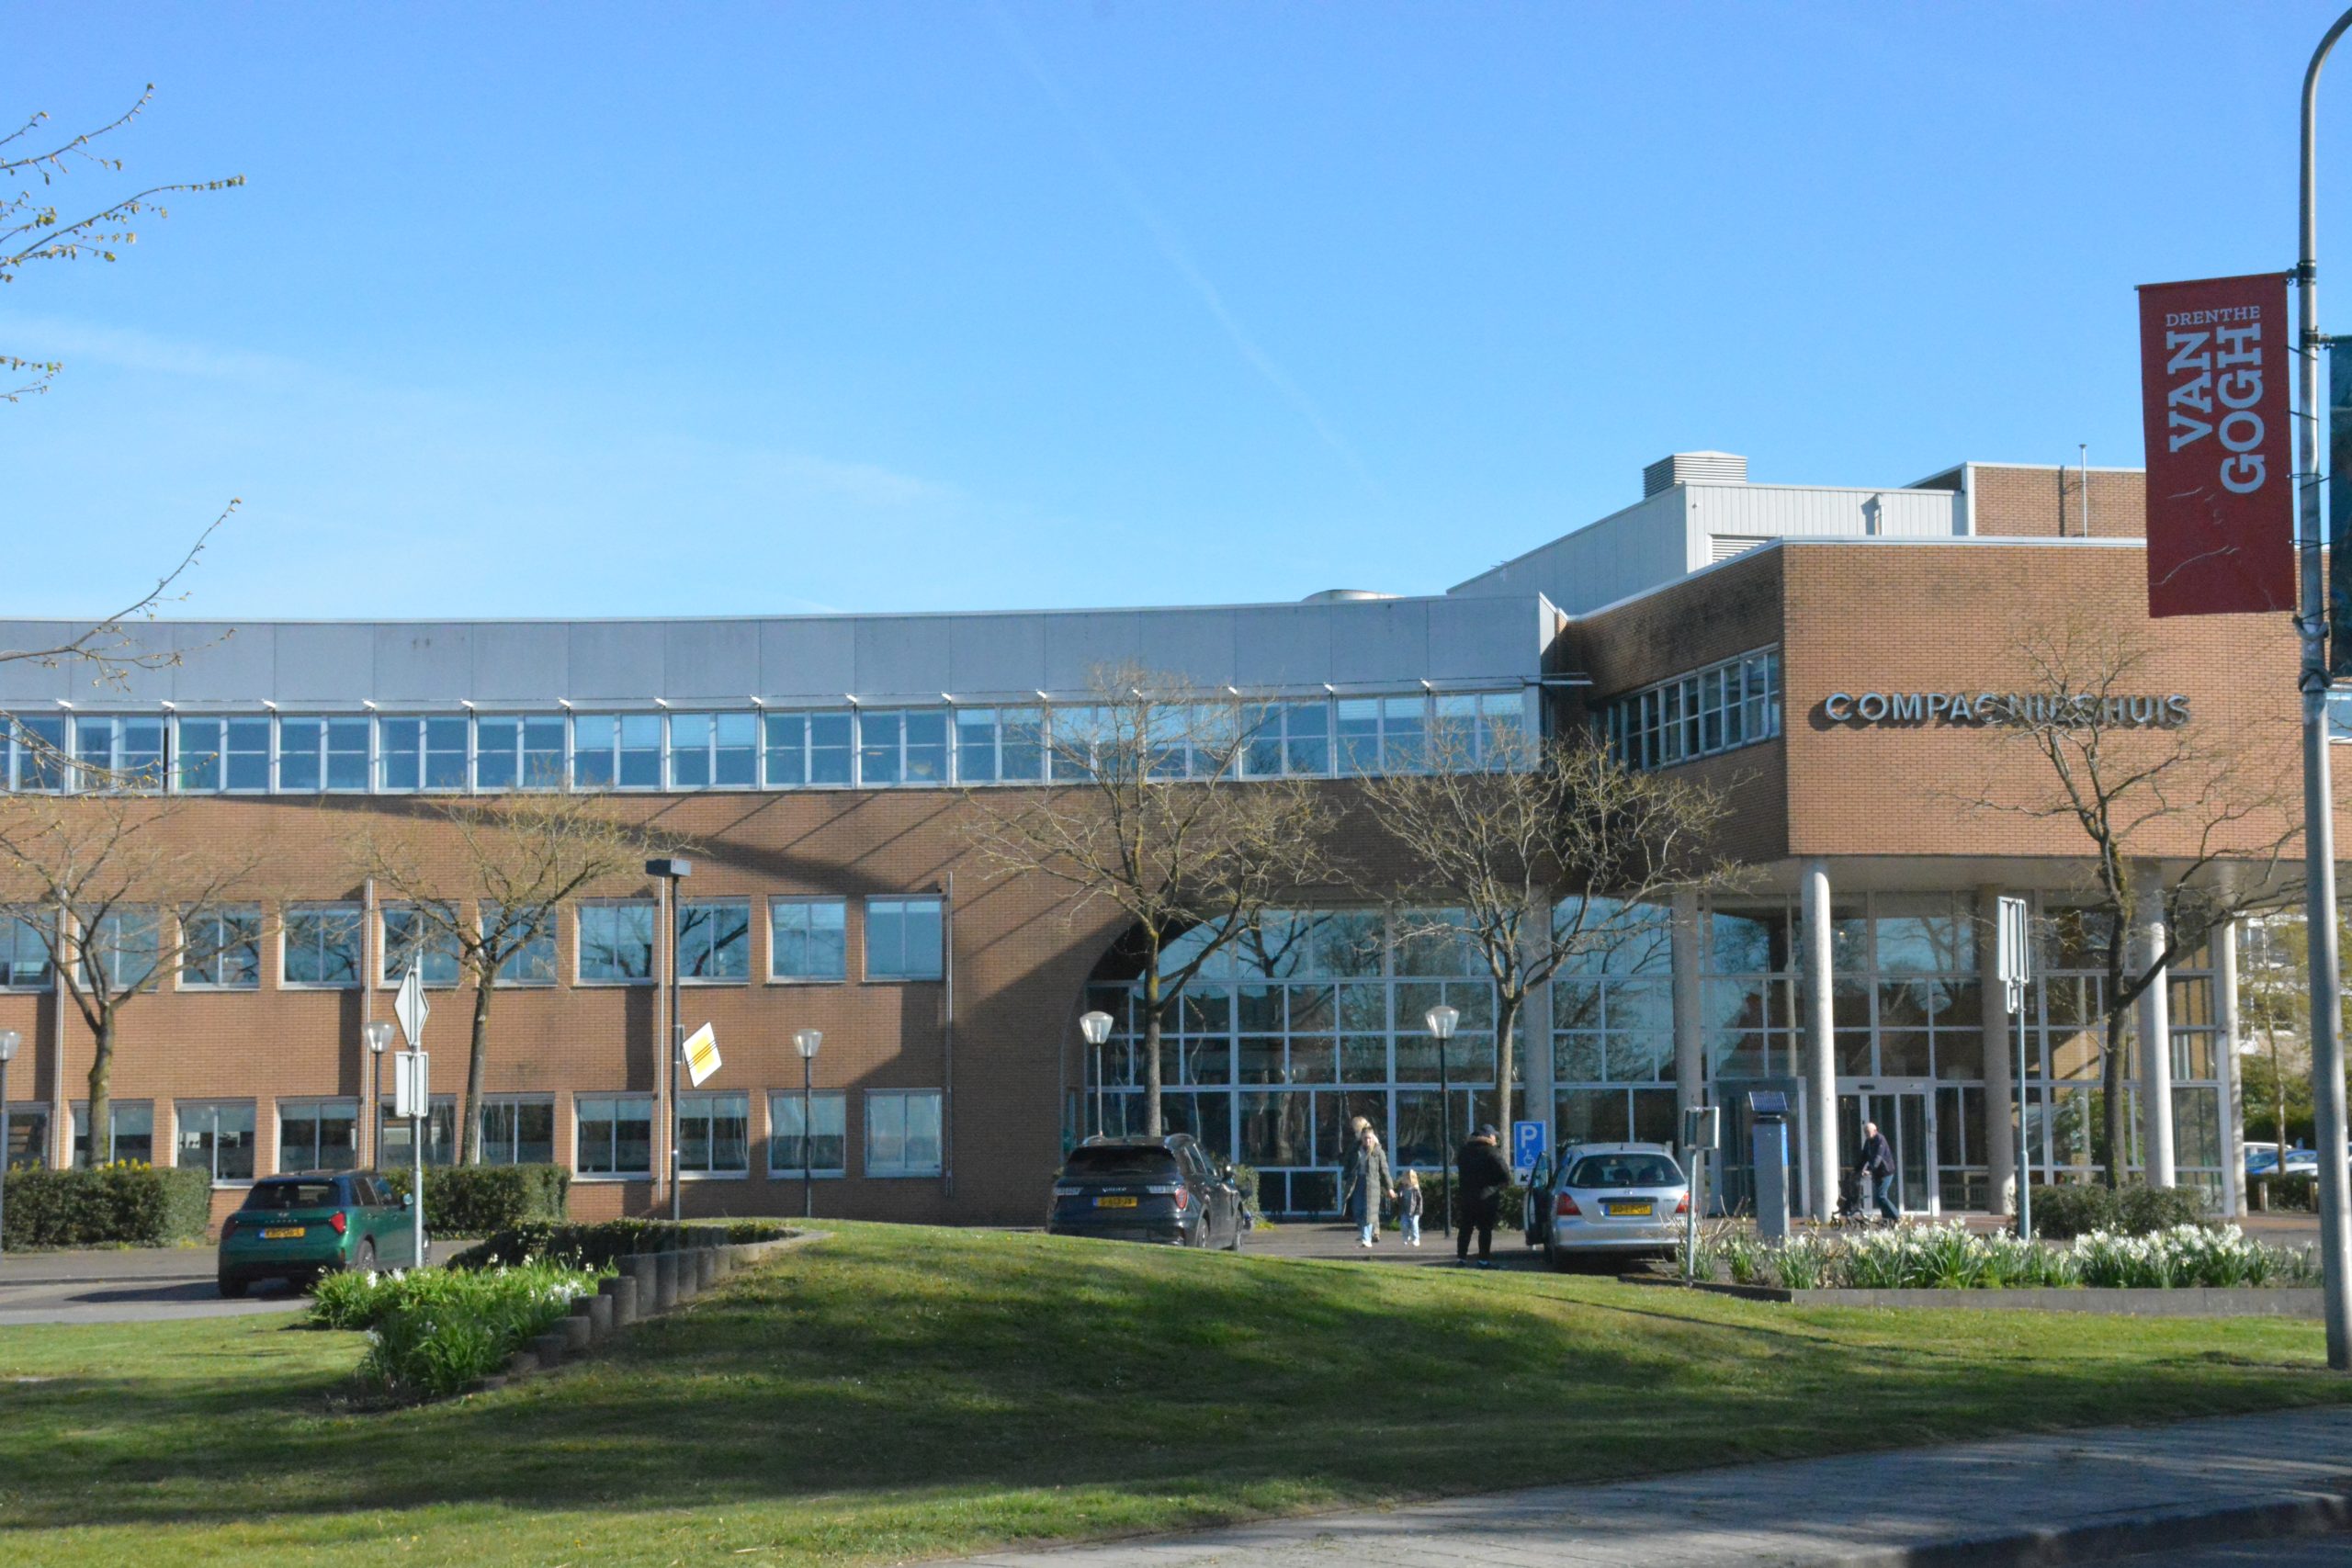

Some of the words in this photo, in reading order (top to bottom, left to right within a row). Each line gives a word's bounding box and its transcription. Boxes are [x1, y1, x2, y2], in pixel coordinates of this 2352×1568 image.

[2165, 305, 2261, 327] DRENTHE
[2165, 330, 2212, 453] VAN
[2216, 322, 2266, 494] GOGH
[1521, 1124, 1538, 1149] P
